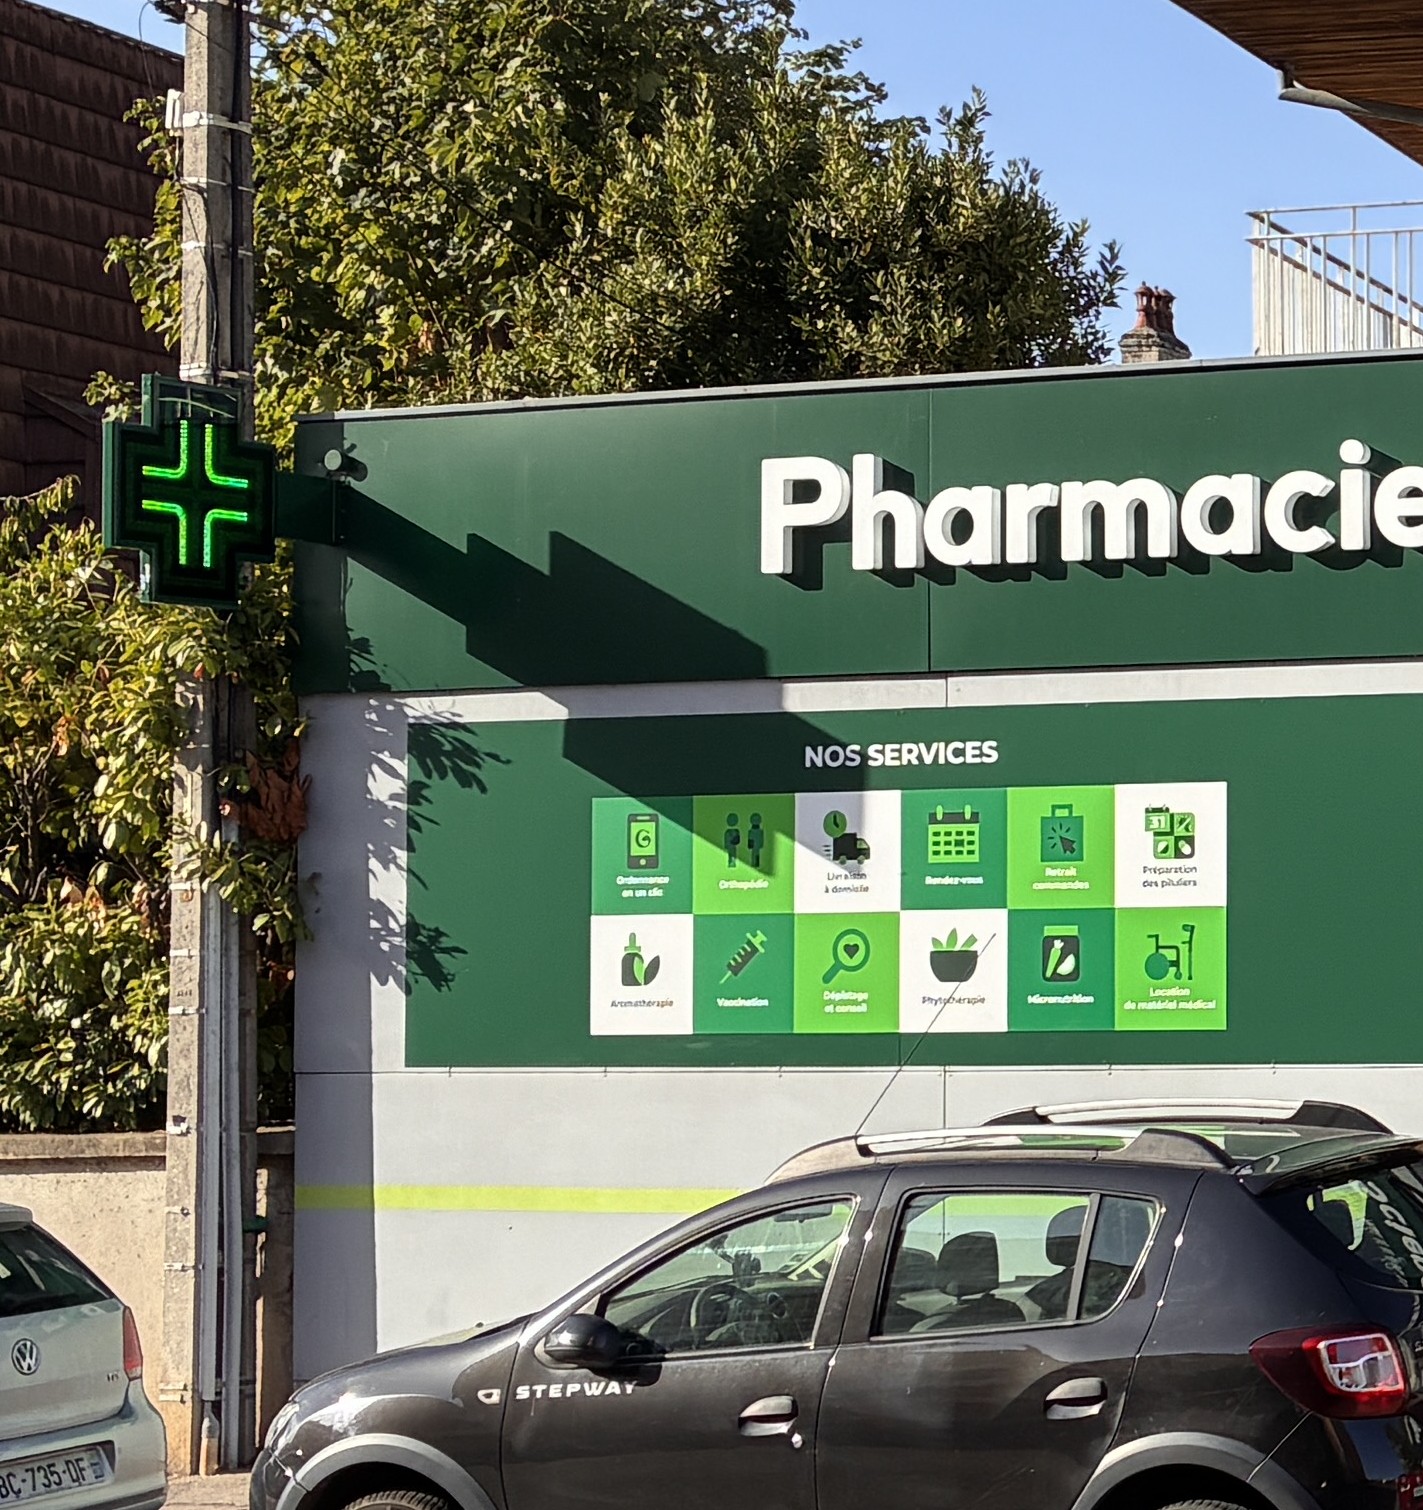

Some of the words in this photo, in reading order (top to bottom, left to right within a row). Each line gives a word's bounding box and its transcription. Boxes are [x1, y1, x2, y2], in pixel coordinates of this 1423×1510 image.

[803, 741, 861, 769] NOS
[866, 739, 998, 768] SERVICES
[1045, 866, 1077, 877] Retrait
[1149, 986, 1191, 998] Location
[717, 997, 769, 1008] Vaccination
[1178, 999, 1217, 1010] médical
[516, 1381, 638, 1400] STEPWAY
